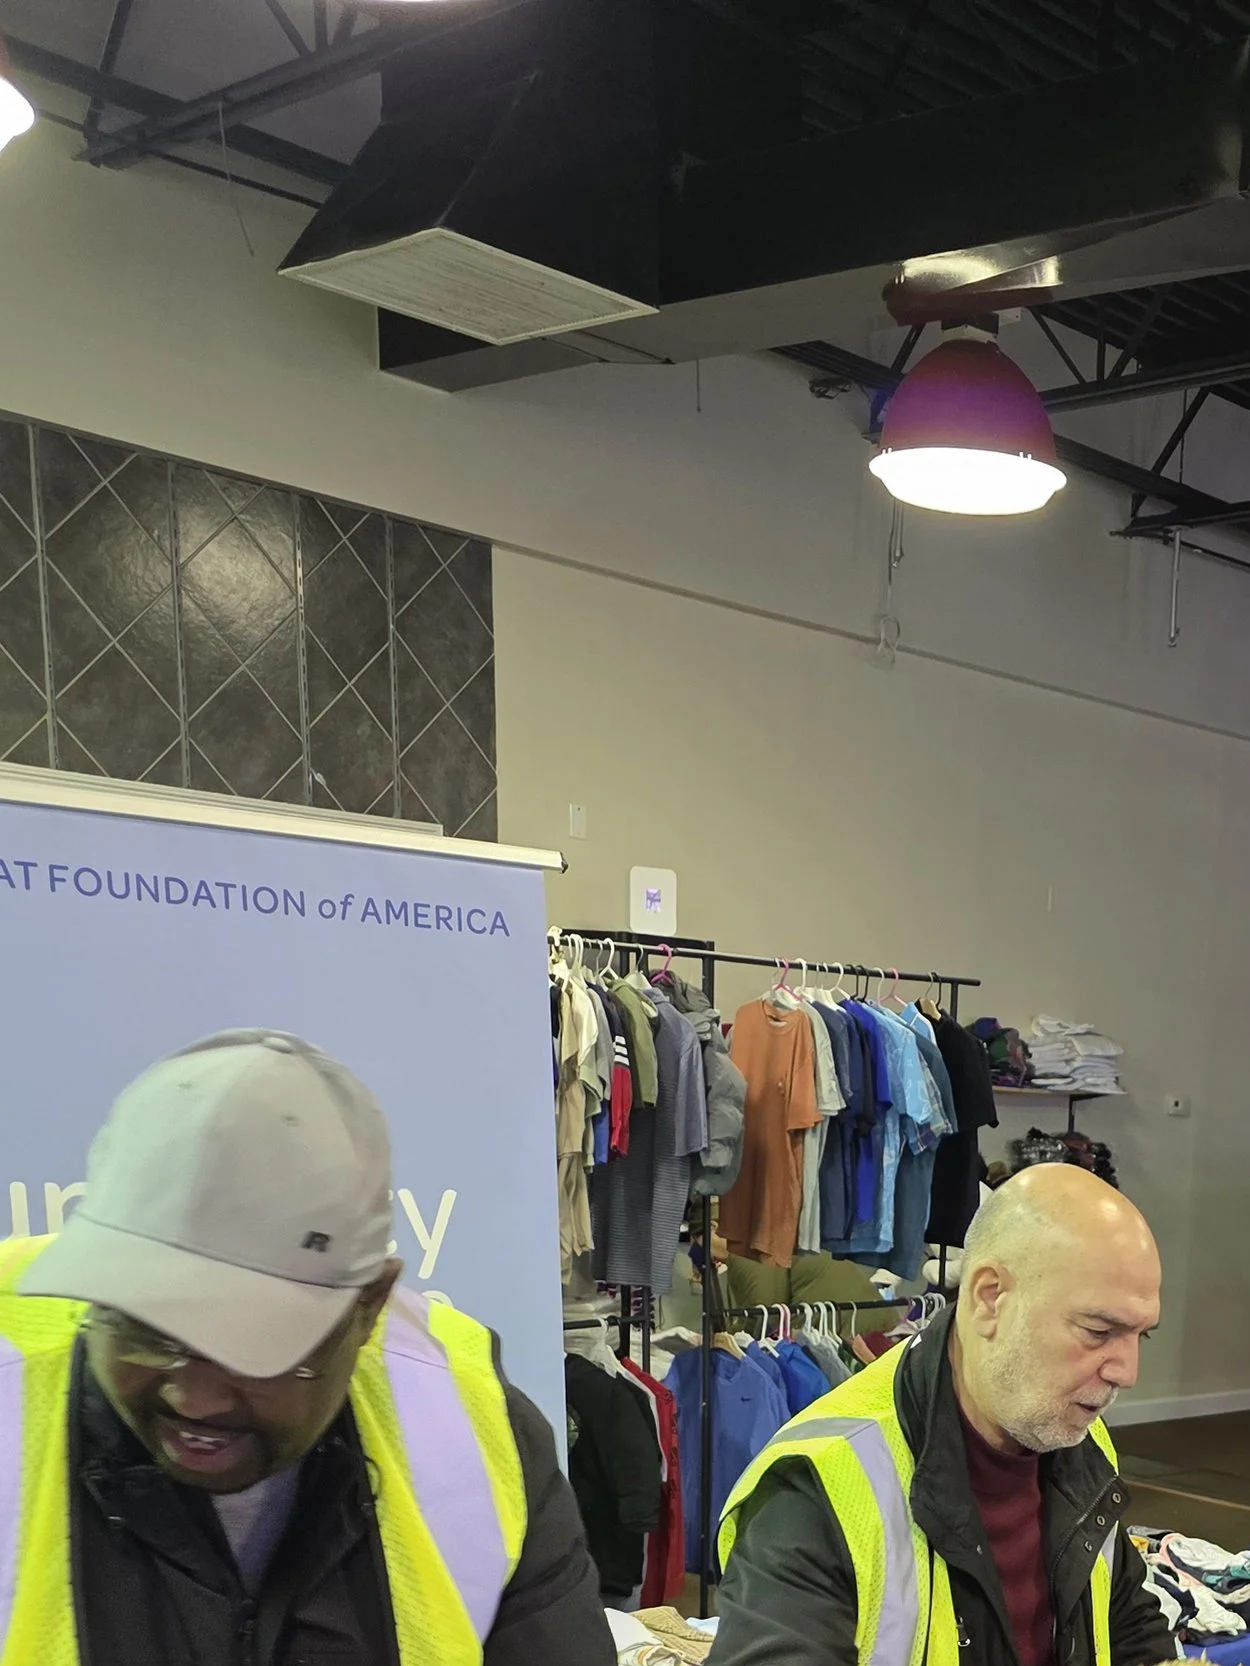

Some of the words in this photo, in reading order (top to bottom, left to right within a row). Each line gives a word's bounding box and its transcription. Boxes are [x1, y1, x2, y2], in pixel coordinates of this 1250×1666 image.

[48, 864, 306, 918] FOUNDATION
[317, 893, 354, 921] of
[360, 896, 511, 938] AMERICA
